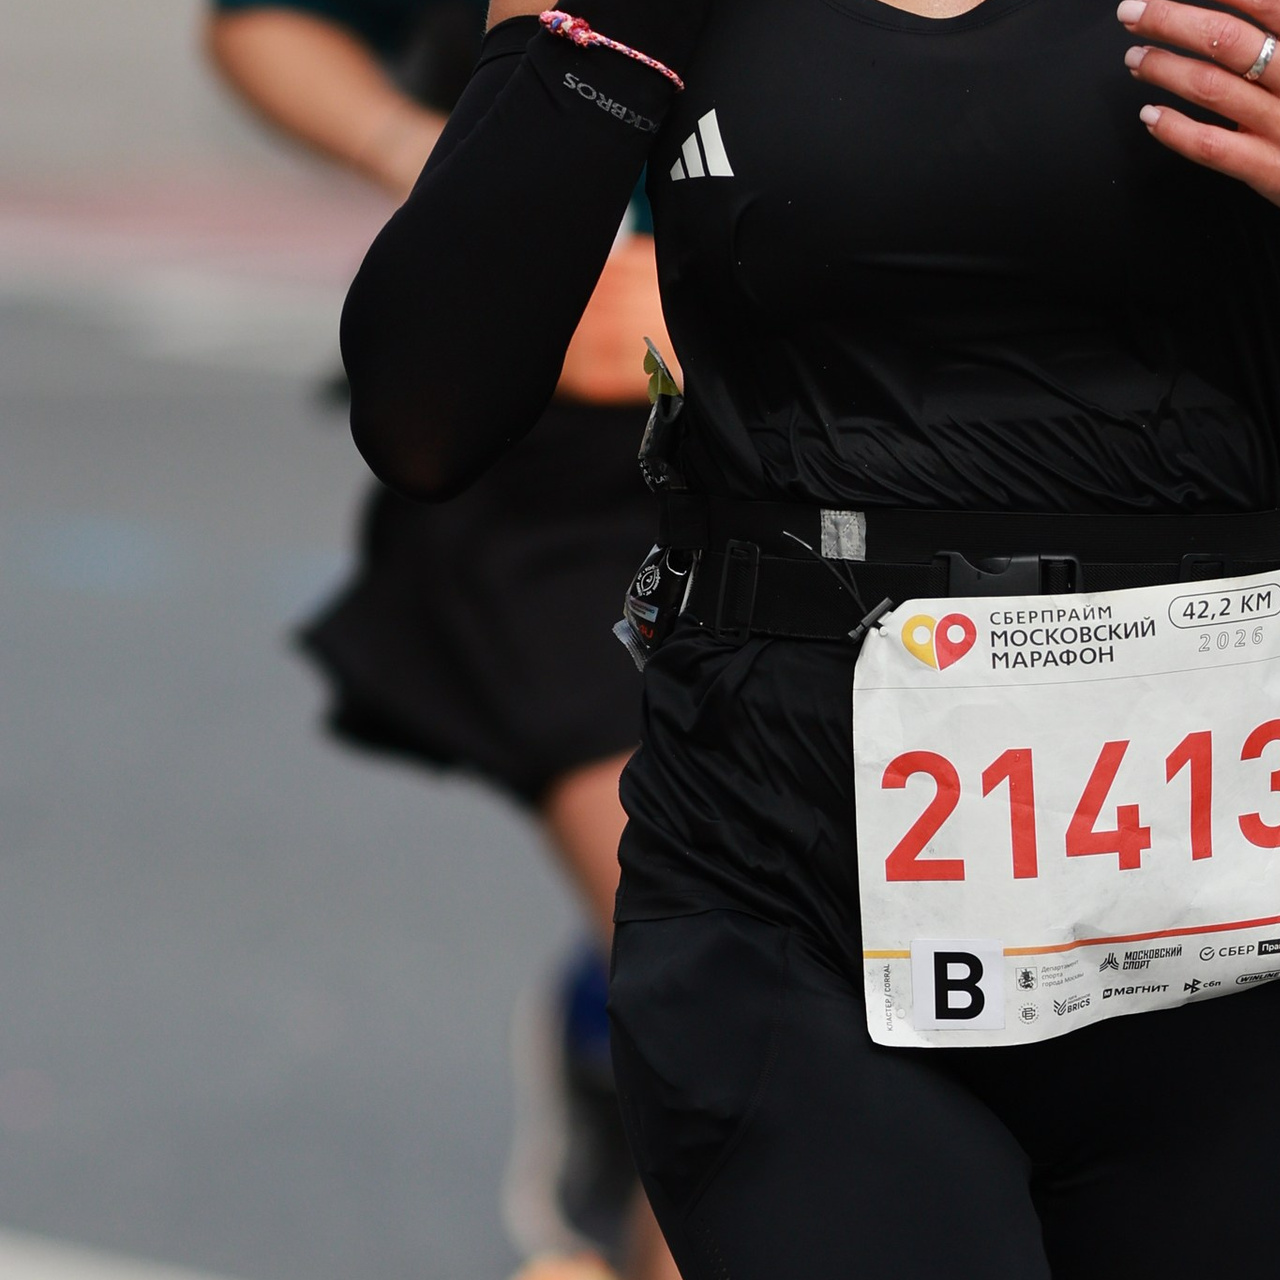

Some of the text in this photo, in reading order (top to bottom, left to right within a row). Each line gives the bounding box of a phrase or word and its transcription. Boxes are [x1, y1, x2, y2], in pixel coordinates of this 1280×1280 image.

[989, 604, 1113, 626] СБЕРПРАЙМ
[1182, 597, 1231, 620] 42,2
[990, 616, 1157, 648] МОСКОВСКИЙ
[1198, 626, 1264, 653] 2026
[991, 645, 1115, 670] МАРАФОН
[1124, 944, 1183, 961] МОСКОВСКИЙ
[1218, 944, 1255, 958] СБЕР
[1041, 959, 1079, 974] Департамент
[1122, 960, 1152, 971] СПОРТ
[883, 964, 891, 993] CORRAL
[933, 951, 985, 1020] B
[1239, 971, 1280, 983] WINLINE
[1067, 998, 1091, 1014] BRICS
